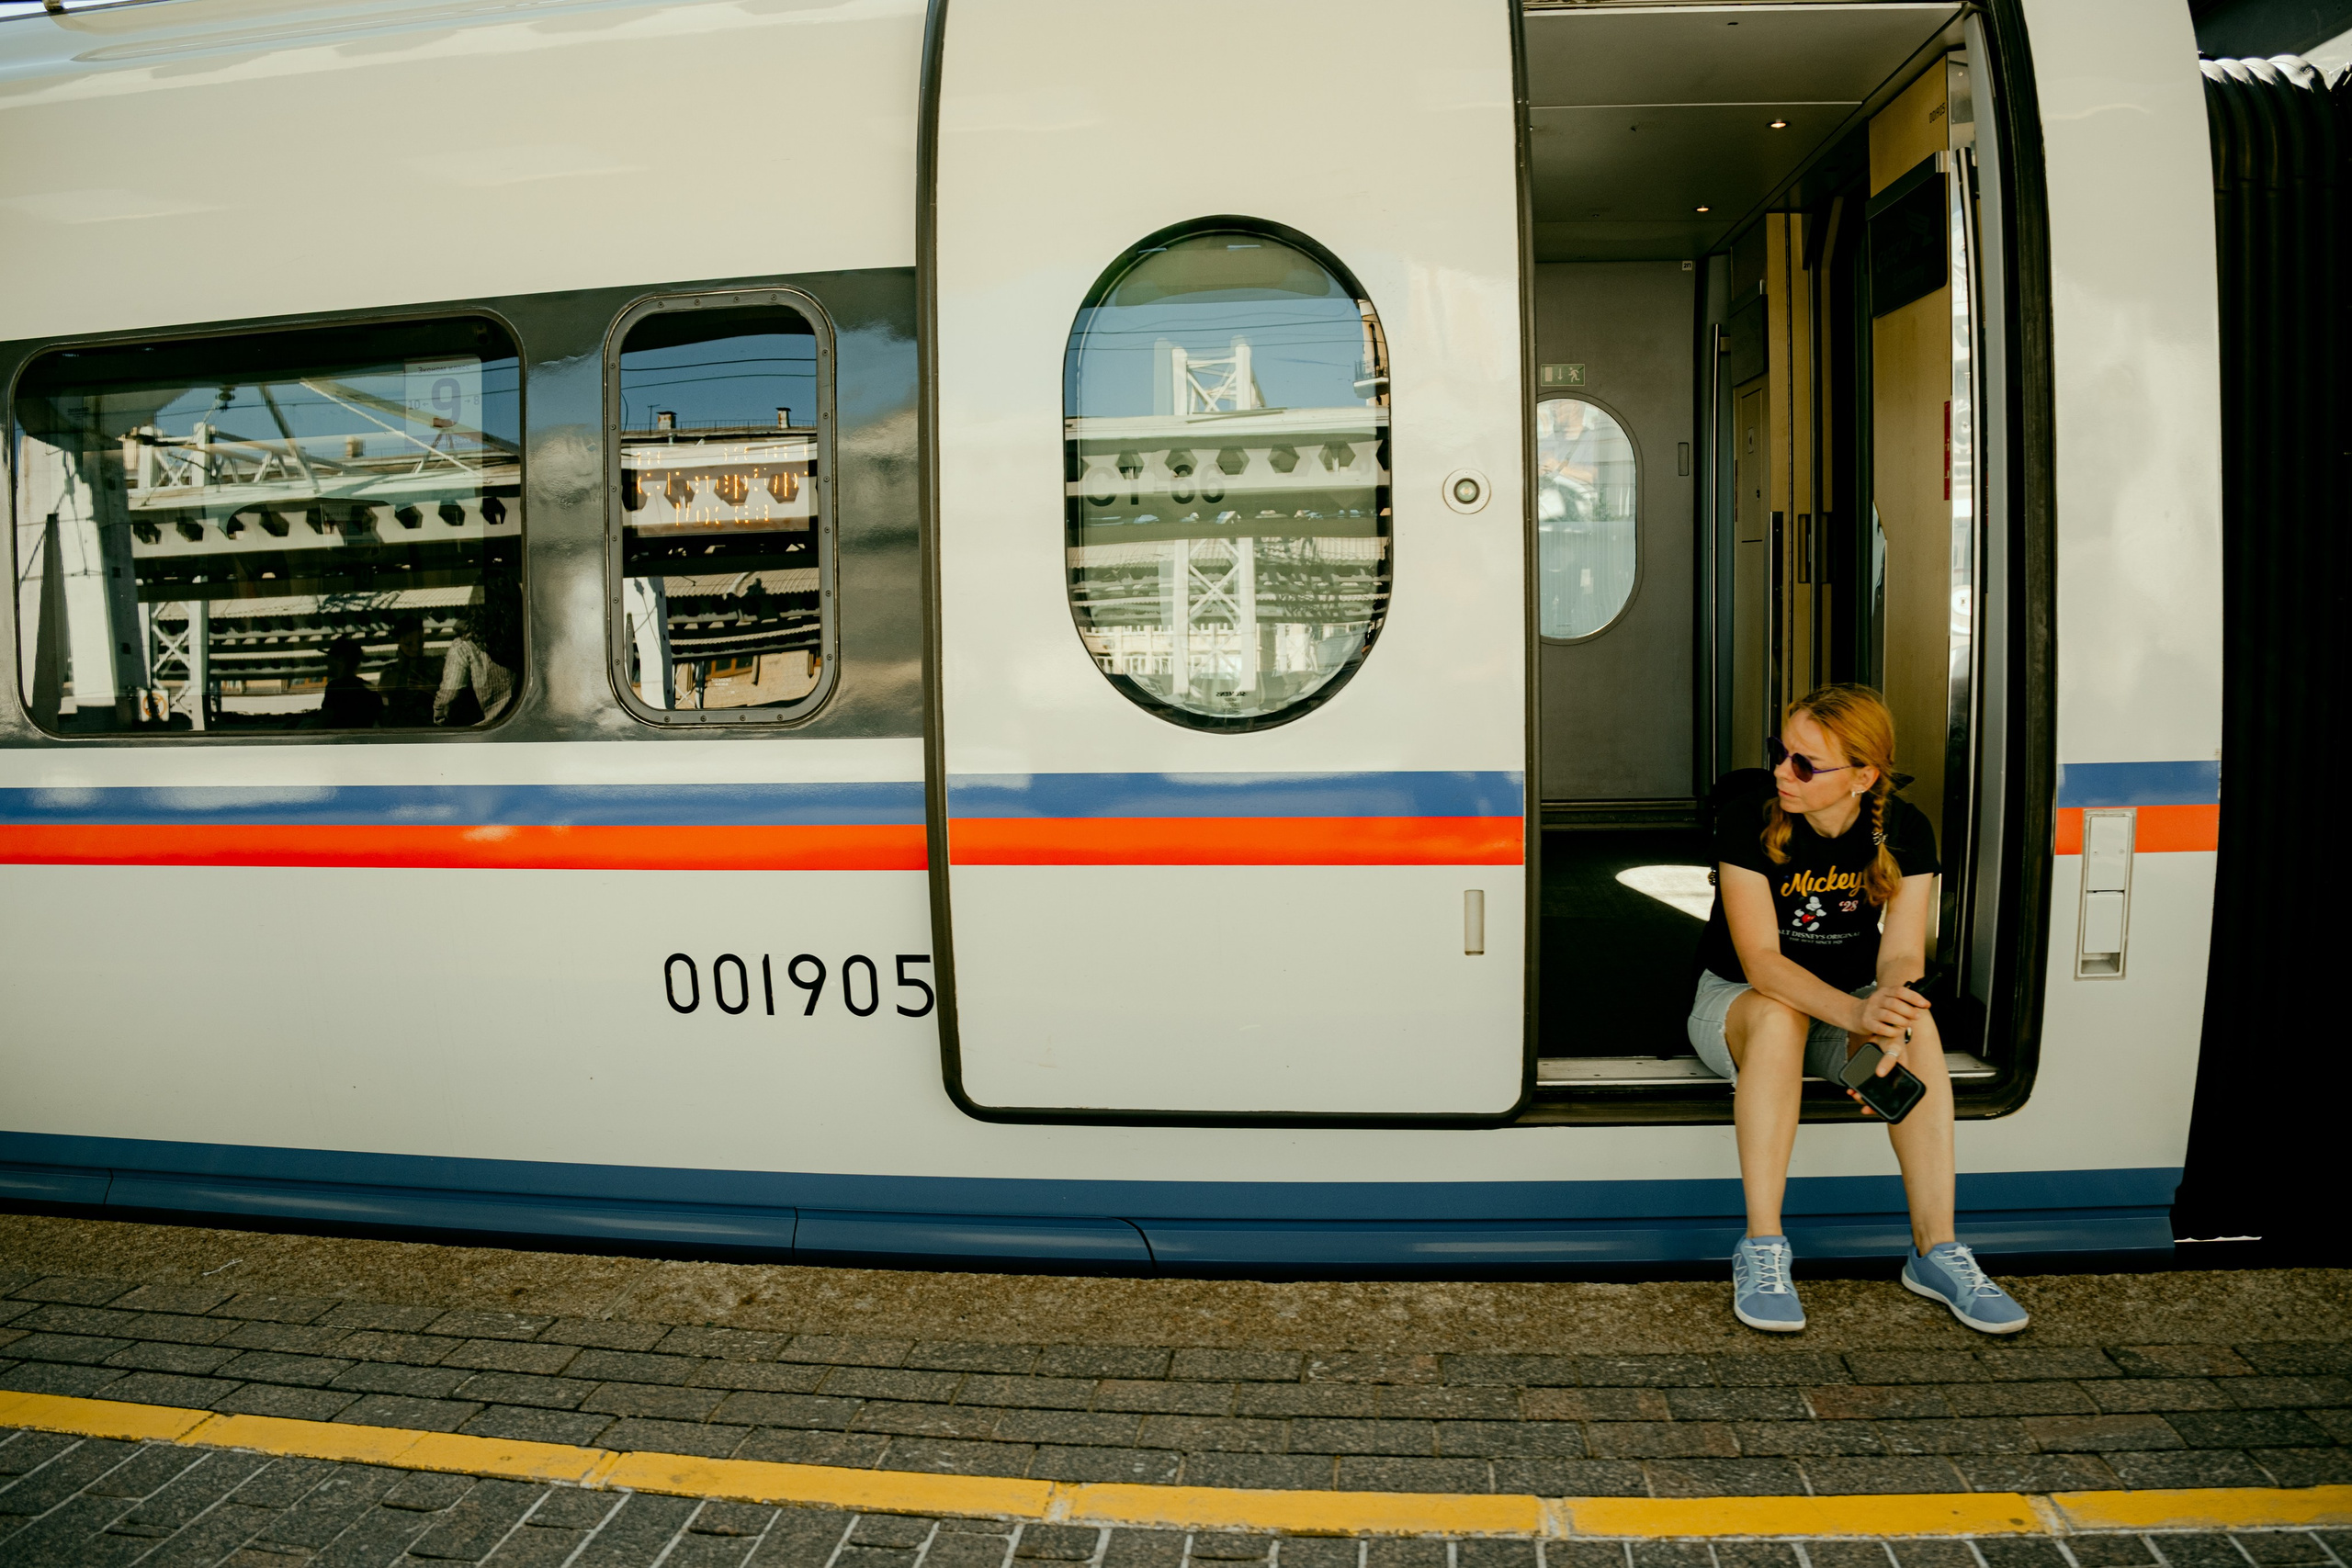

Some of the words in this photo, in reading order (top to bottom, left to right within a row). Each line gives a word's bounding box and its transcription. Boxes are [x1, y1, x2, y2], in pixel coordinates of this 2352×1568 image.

[1929, 102, 1945, 124] 001905
[408, 399, 420, 410] 10
[432, 378, 461, 428] 9
[473, 395, 480, 405] 8
[1781, 865, 1866, 897] Mickey
[664, 953, 934, 1018] 001905
